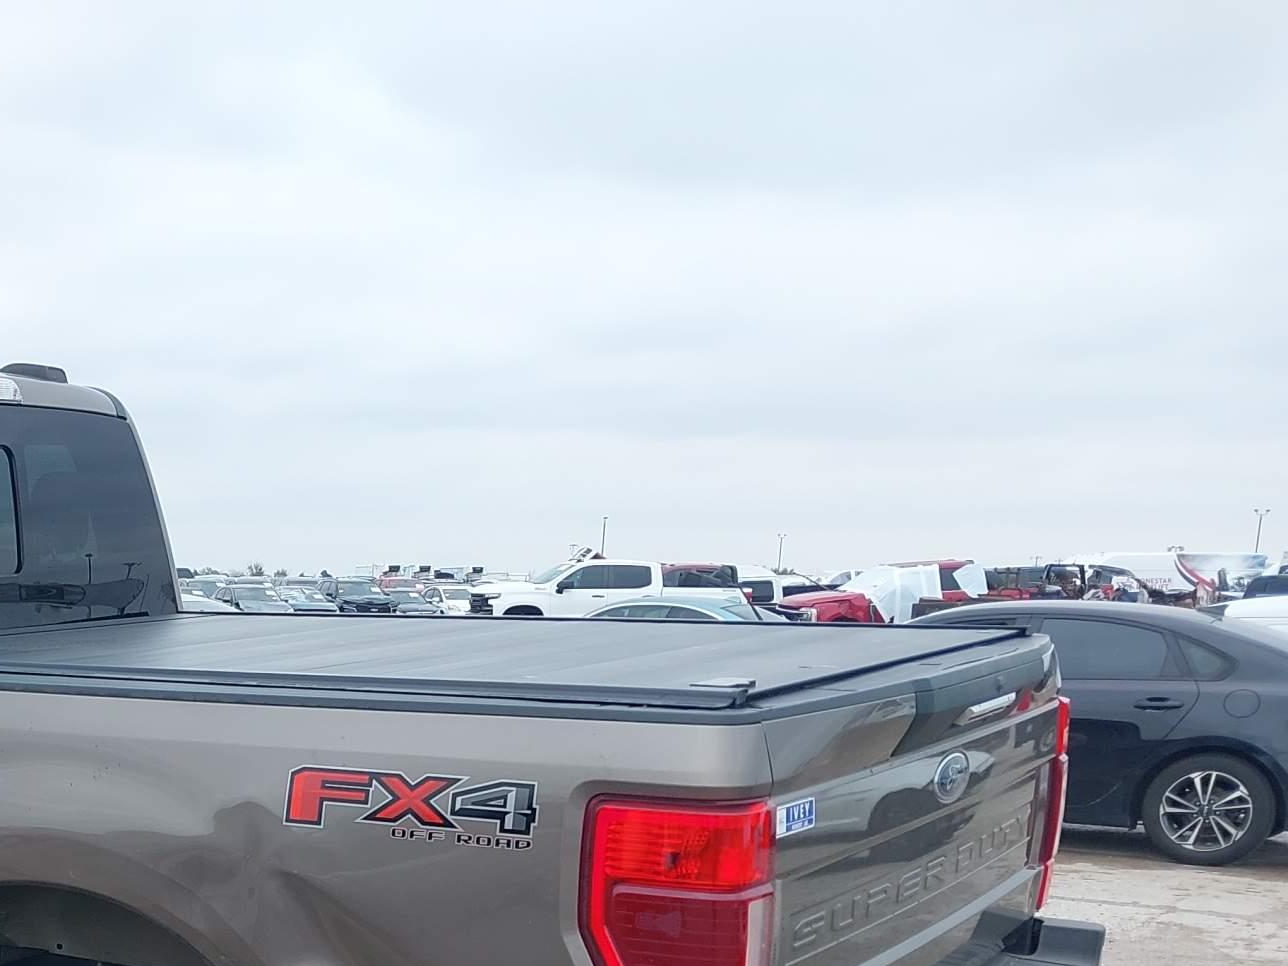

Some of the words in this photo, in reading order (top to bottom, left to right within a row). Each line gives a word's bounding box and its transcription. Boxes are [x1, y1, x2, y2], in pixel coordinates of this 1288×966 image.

[283, 765, 539, 837] FX4
[789, 801, 810, 822] IVEY
[390, 827, 446, 843] OFF
[455, 833, 533, 851] ROAD
[793, 855, 948, 950] SUPER
[954, 816, 1024, 874] DUTY
